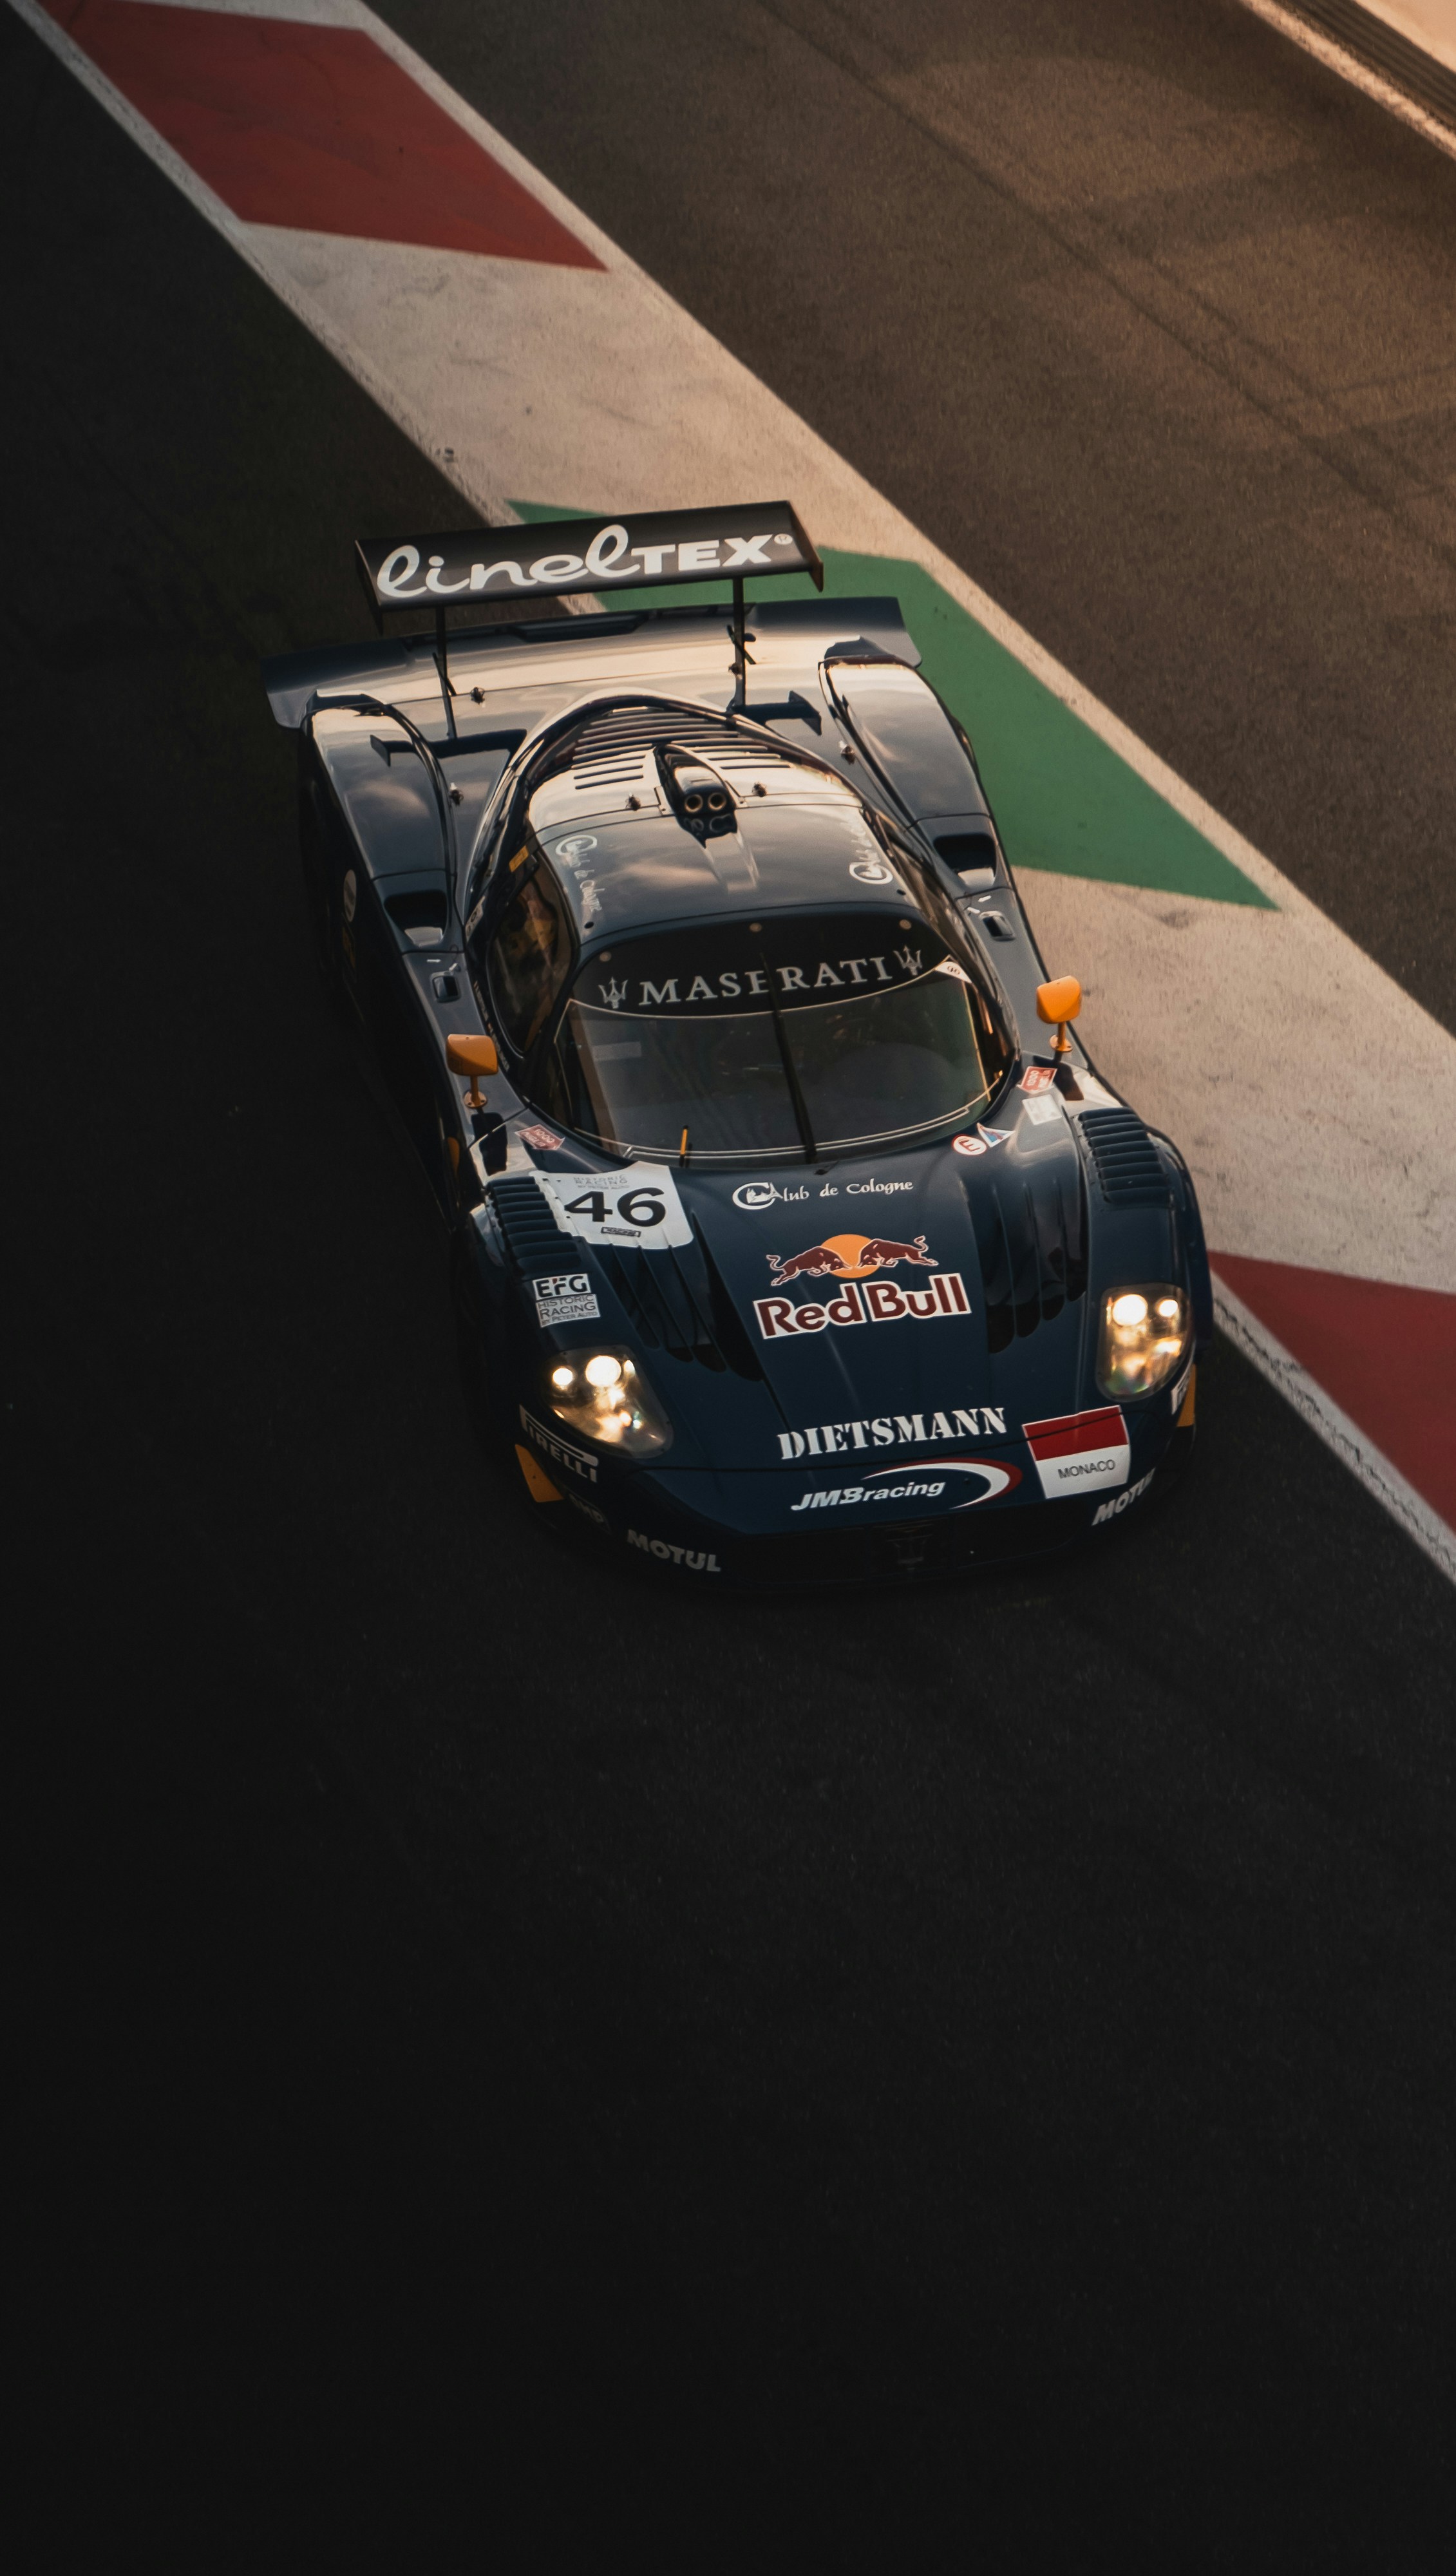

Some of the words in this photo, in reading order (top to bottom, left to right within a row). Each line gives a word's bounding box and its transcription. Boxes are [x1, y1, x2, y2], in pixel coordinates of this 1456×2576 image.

[638, 956, 893, 1005] MASERATI
[564, 1187, 666, 1227] 46
[819, 1182, 838, 1197] de
[846, 1178, 914, 1195] Cologne
[535, 1275, 588, 1298] EFG
[538, 1294, 594, 1308] HISTORIC
[753, 1283, 867, 1339] Red
[862, 1273, 971, 1321] Bull
[540, 1302, 596, 1319] RACING
[520, 1405, 598, 1482] PIRELLI
[777, 1408, 1007, 1460] DIETSMANN
[1057, 1459, 1116, 1479] MONACO
[627, 1529, 721, 1572] MOTUL
